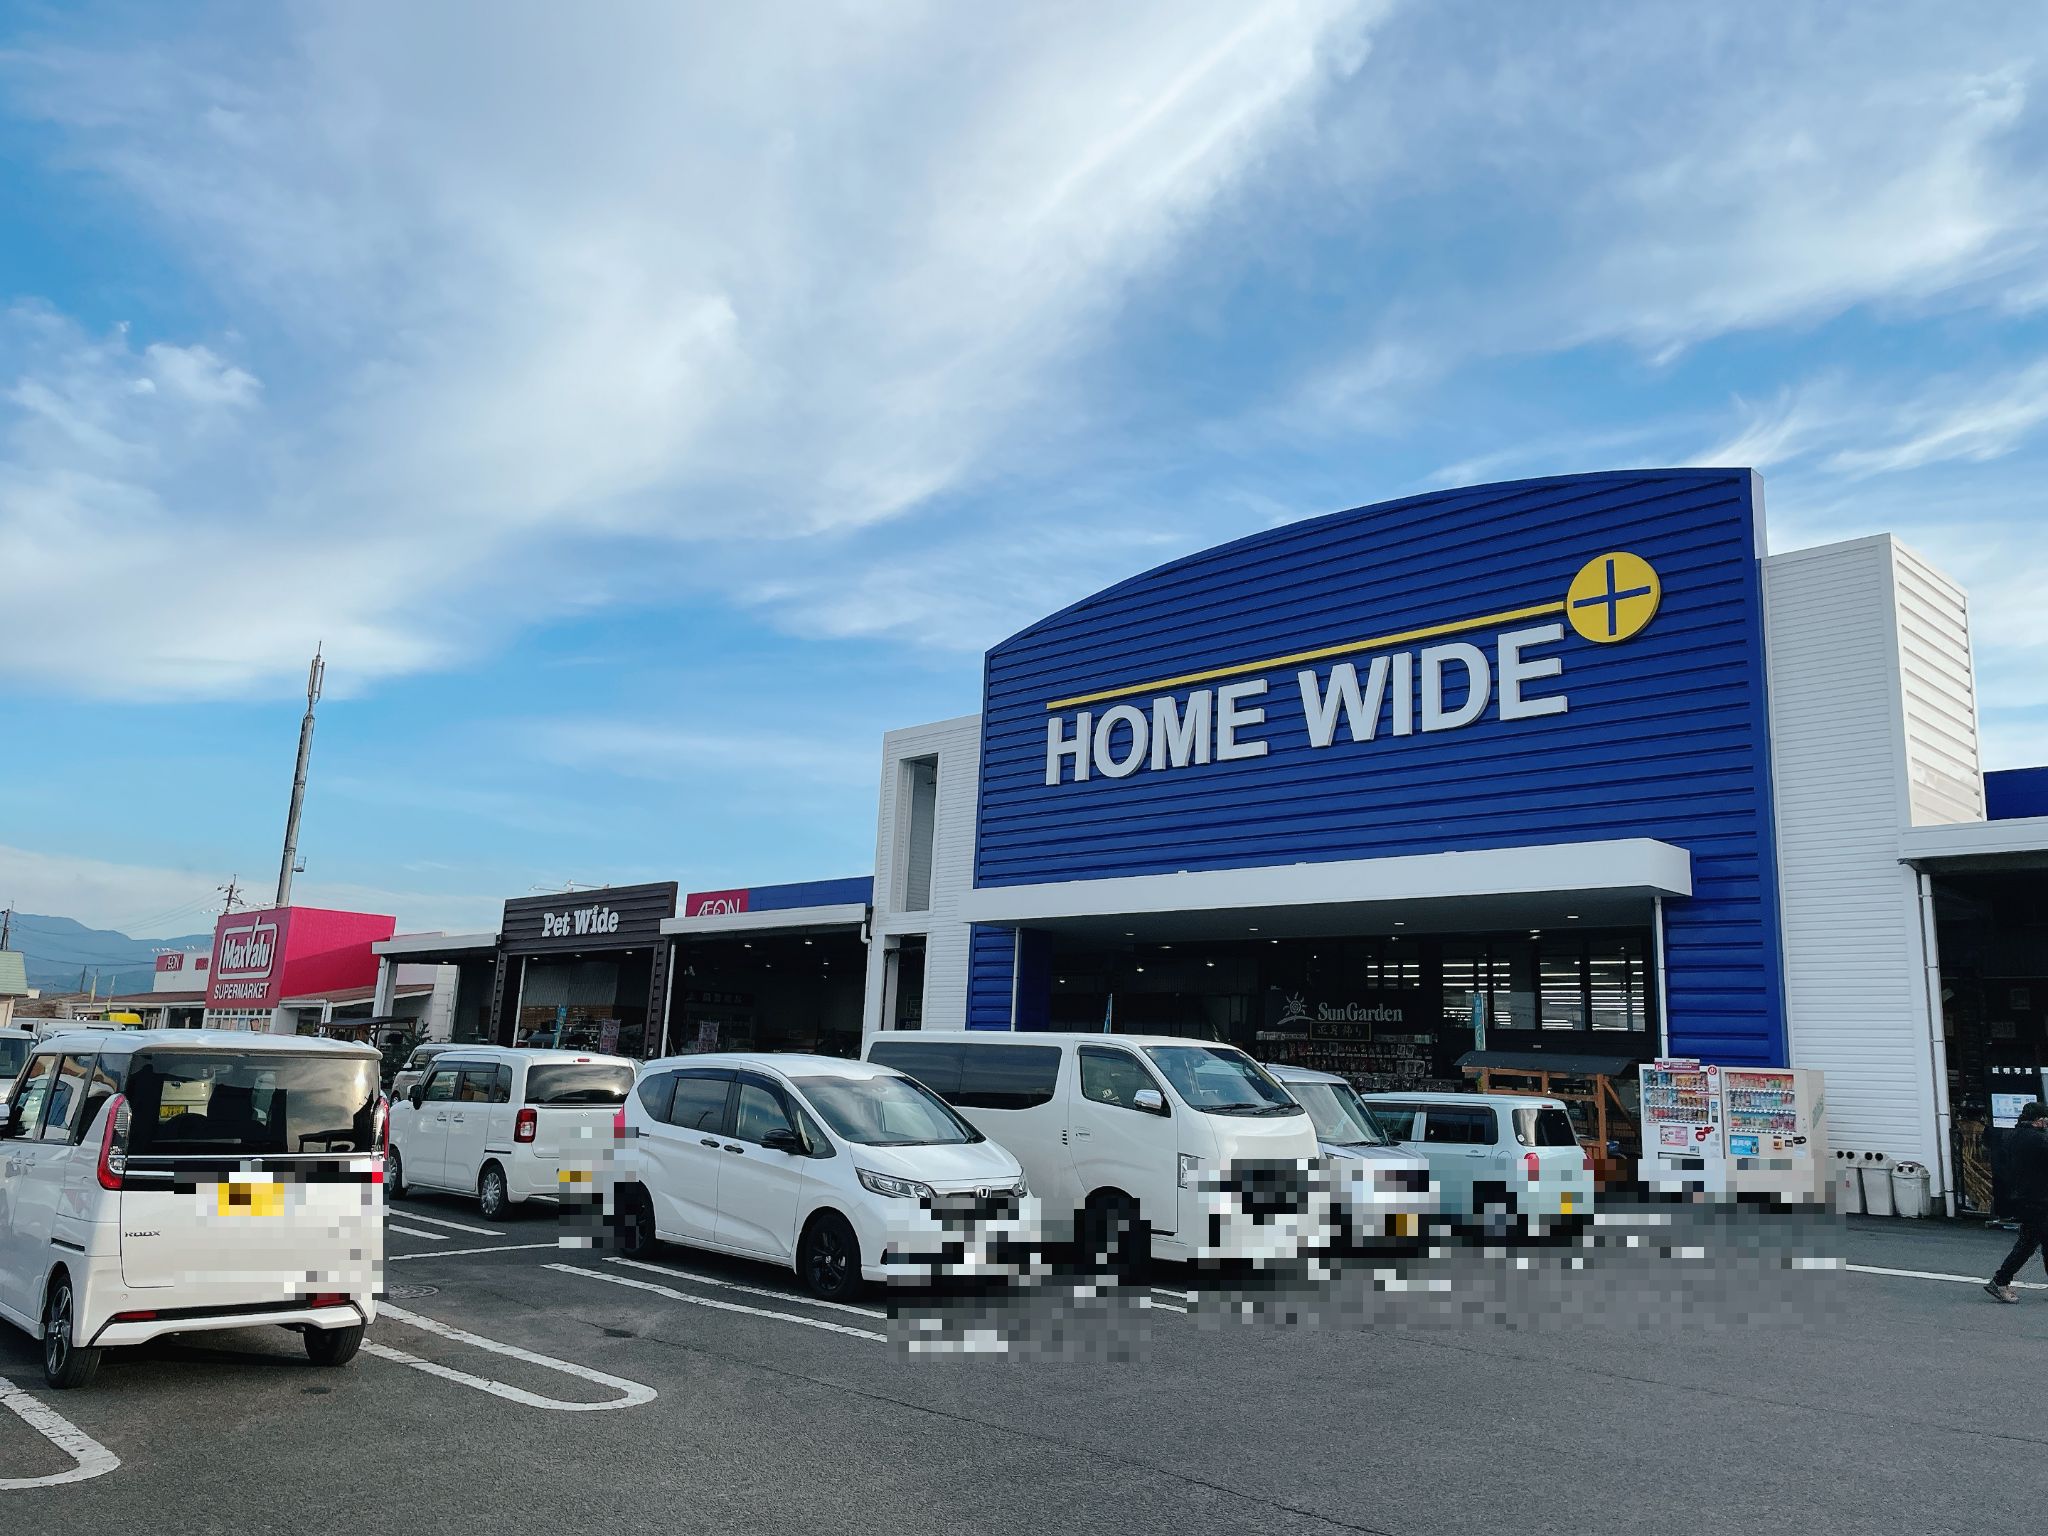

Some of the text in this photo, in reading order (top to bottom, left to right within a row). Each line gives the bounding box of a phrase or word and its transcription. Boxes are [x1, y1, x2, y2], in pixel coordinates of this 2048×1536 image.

[1045, 623, 1569, 787] HOME WIDE
[541, 905, 619, 937] Pet Wide
[222, 916, 271, 969] MaxValu
[213, 982, 270, 999] SUPERMARKET
